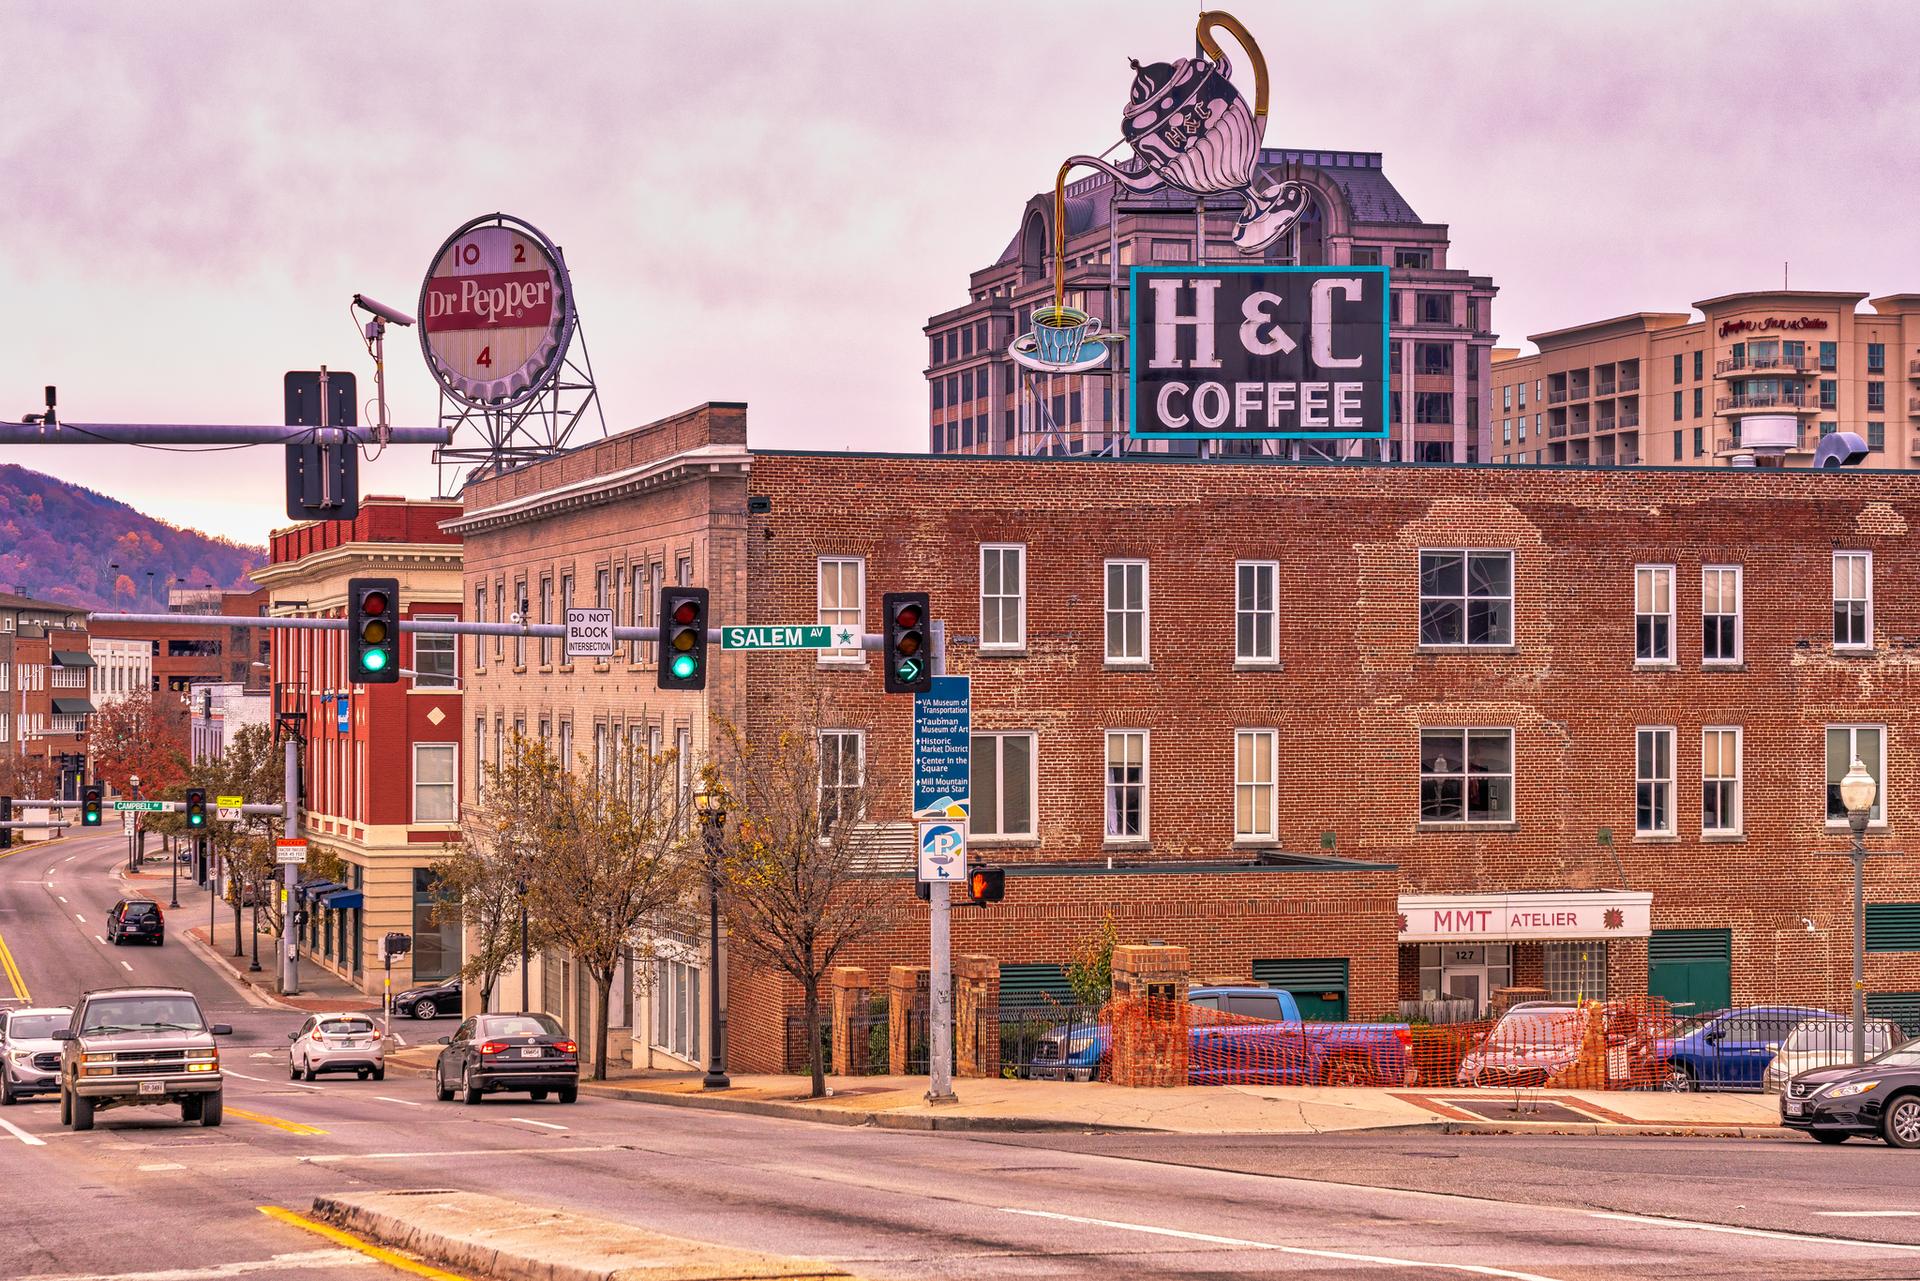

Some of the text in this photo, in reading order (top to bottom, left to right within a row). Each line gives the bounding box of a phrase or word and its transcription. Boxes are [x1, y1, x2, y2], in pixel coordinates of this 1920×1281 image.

[455, 244, 526, 267] 10 2
[429, 280, 550, 323] Dr Pepper
[1149, 278, 1362, 368] H & C
[477, 346, 492, 368] 4
[1156, 381, 1363, 428] COFFEE
[569, 613, 610, 622] DO NOT
[571, 627, 608, 637] BLOCK
[730, 628, 823, 646] SALEM AV
[569, 642, 611, 651] INTERSECTION
[961, 698, 968, 706] of
[923, 706, 968, 715] Transportation
[950, 725, 957, 733] of
[921, 765, 948, 773] Square
[937, 785, 950, 793] and
[951, 785, 965, 793] Star
[117, 802, 152, 810] CAMPBELL
[934, 834, 954, 856] P
[1433, 910, 1578, 932] MMT ATELIER
[1456, 951, 1474, 960] 127
